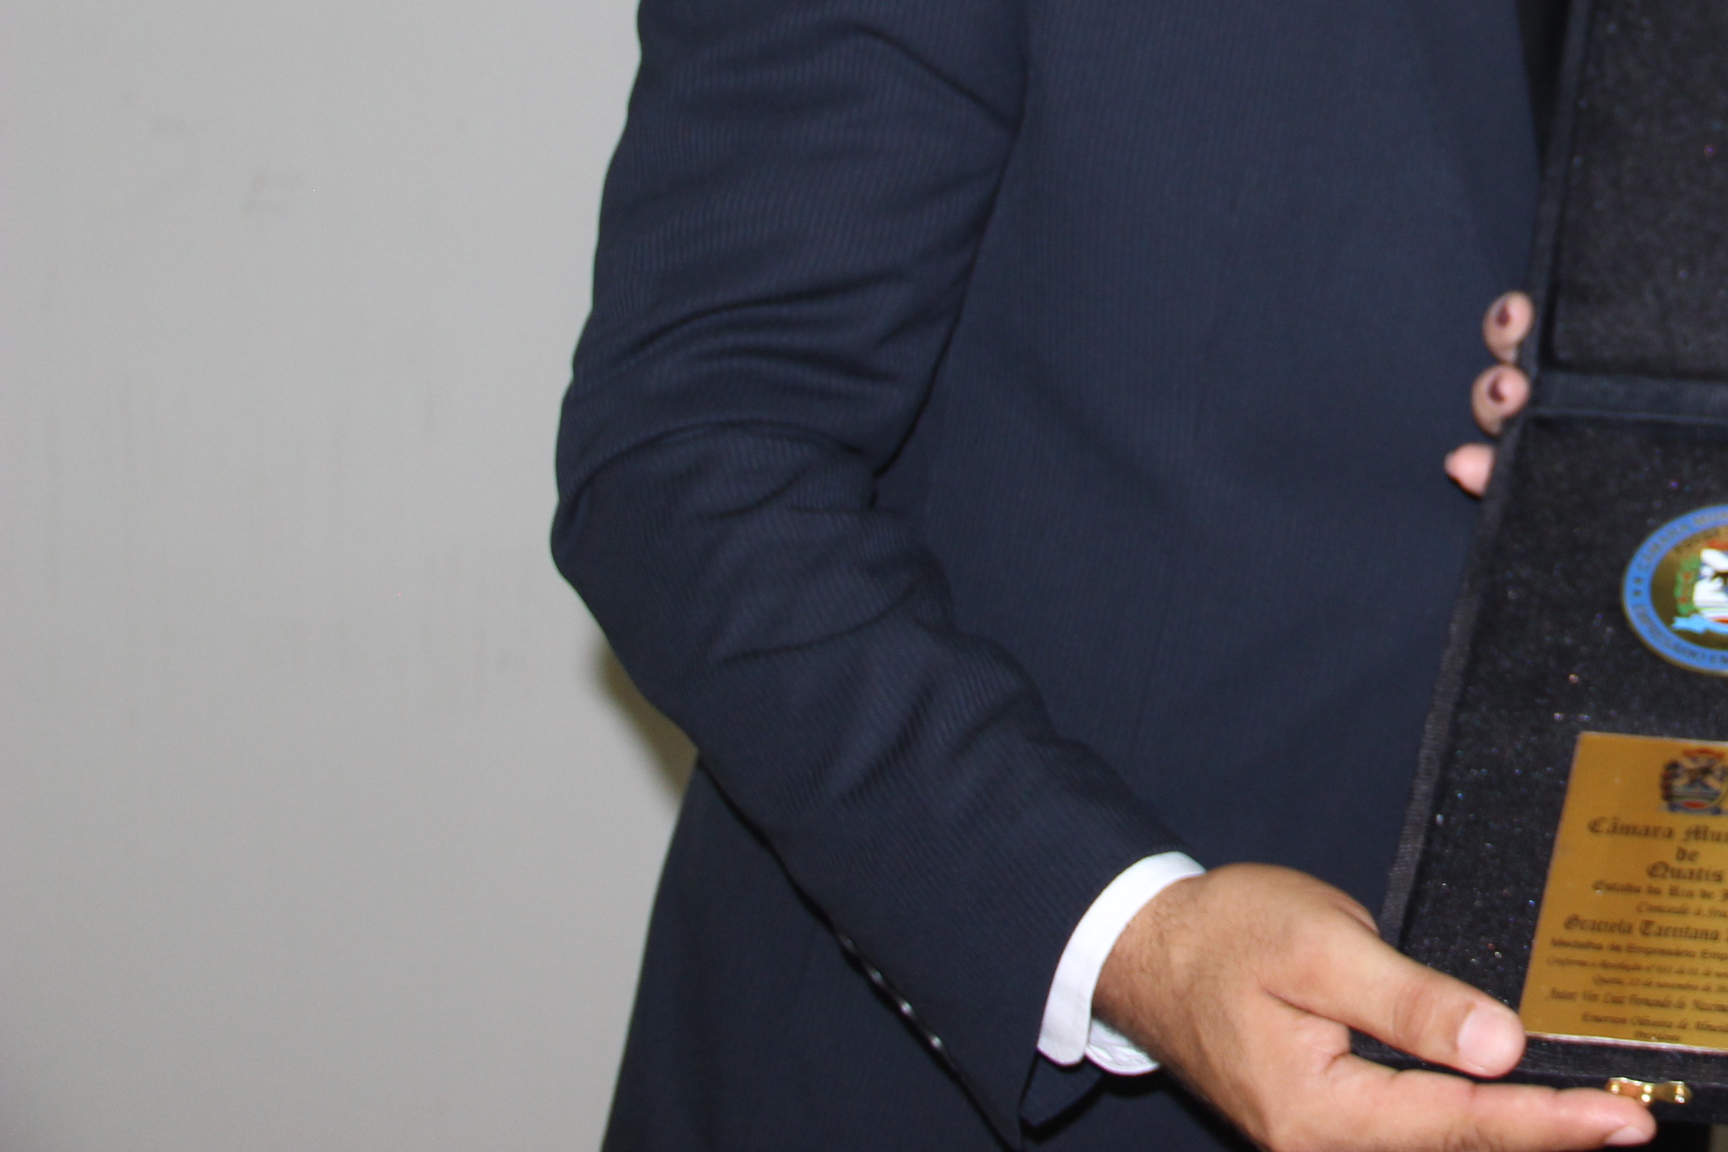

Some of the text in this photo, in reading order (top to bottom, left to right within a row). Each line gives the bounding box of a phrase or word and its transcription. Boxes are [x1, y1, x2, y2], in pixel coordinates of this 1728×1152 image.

[1587, 815, 1674, 840] Câmara
[1675, 845, 1700, 862] de
[1645, 860, 1725, 883] Quatis
[1668, 885, 1694, 899] Rio
